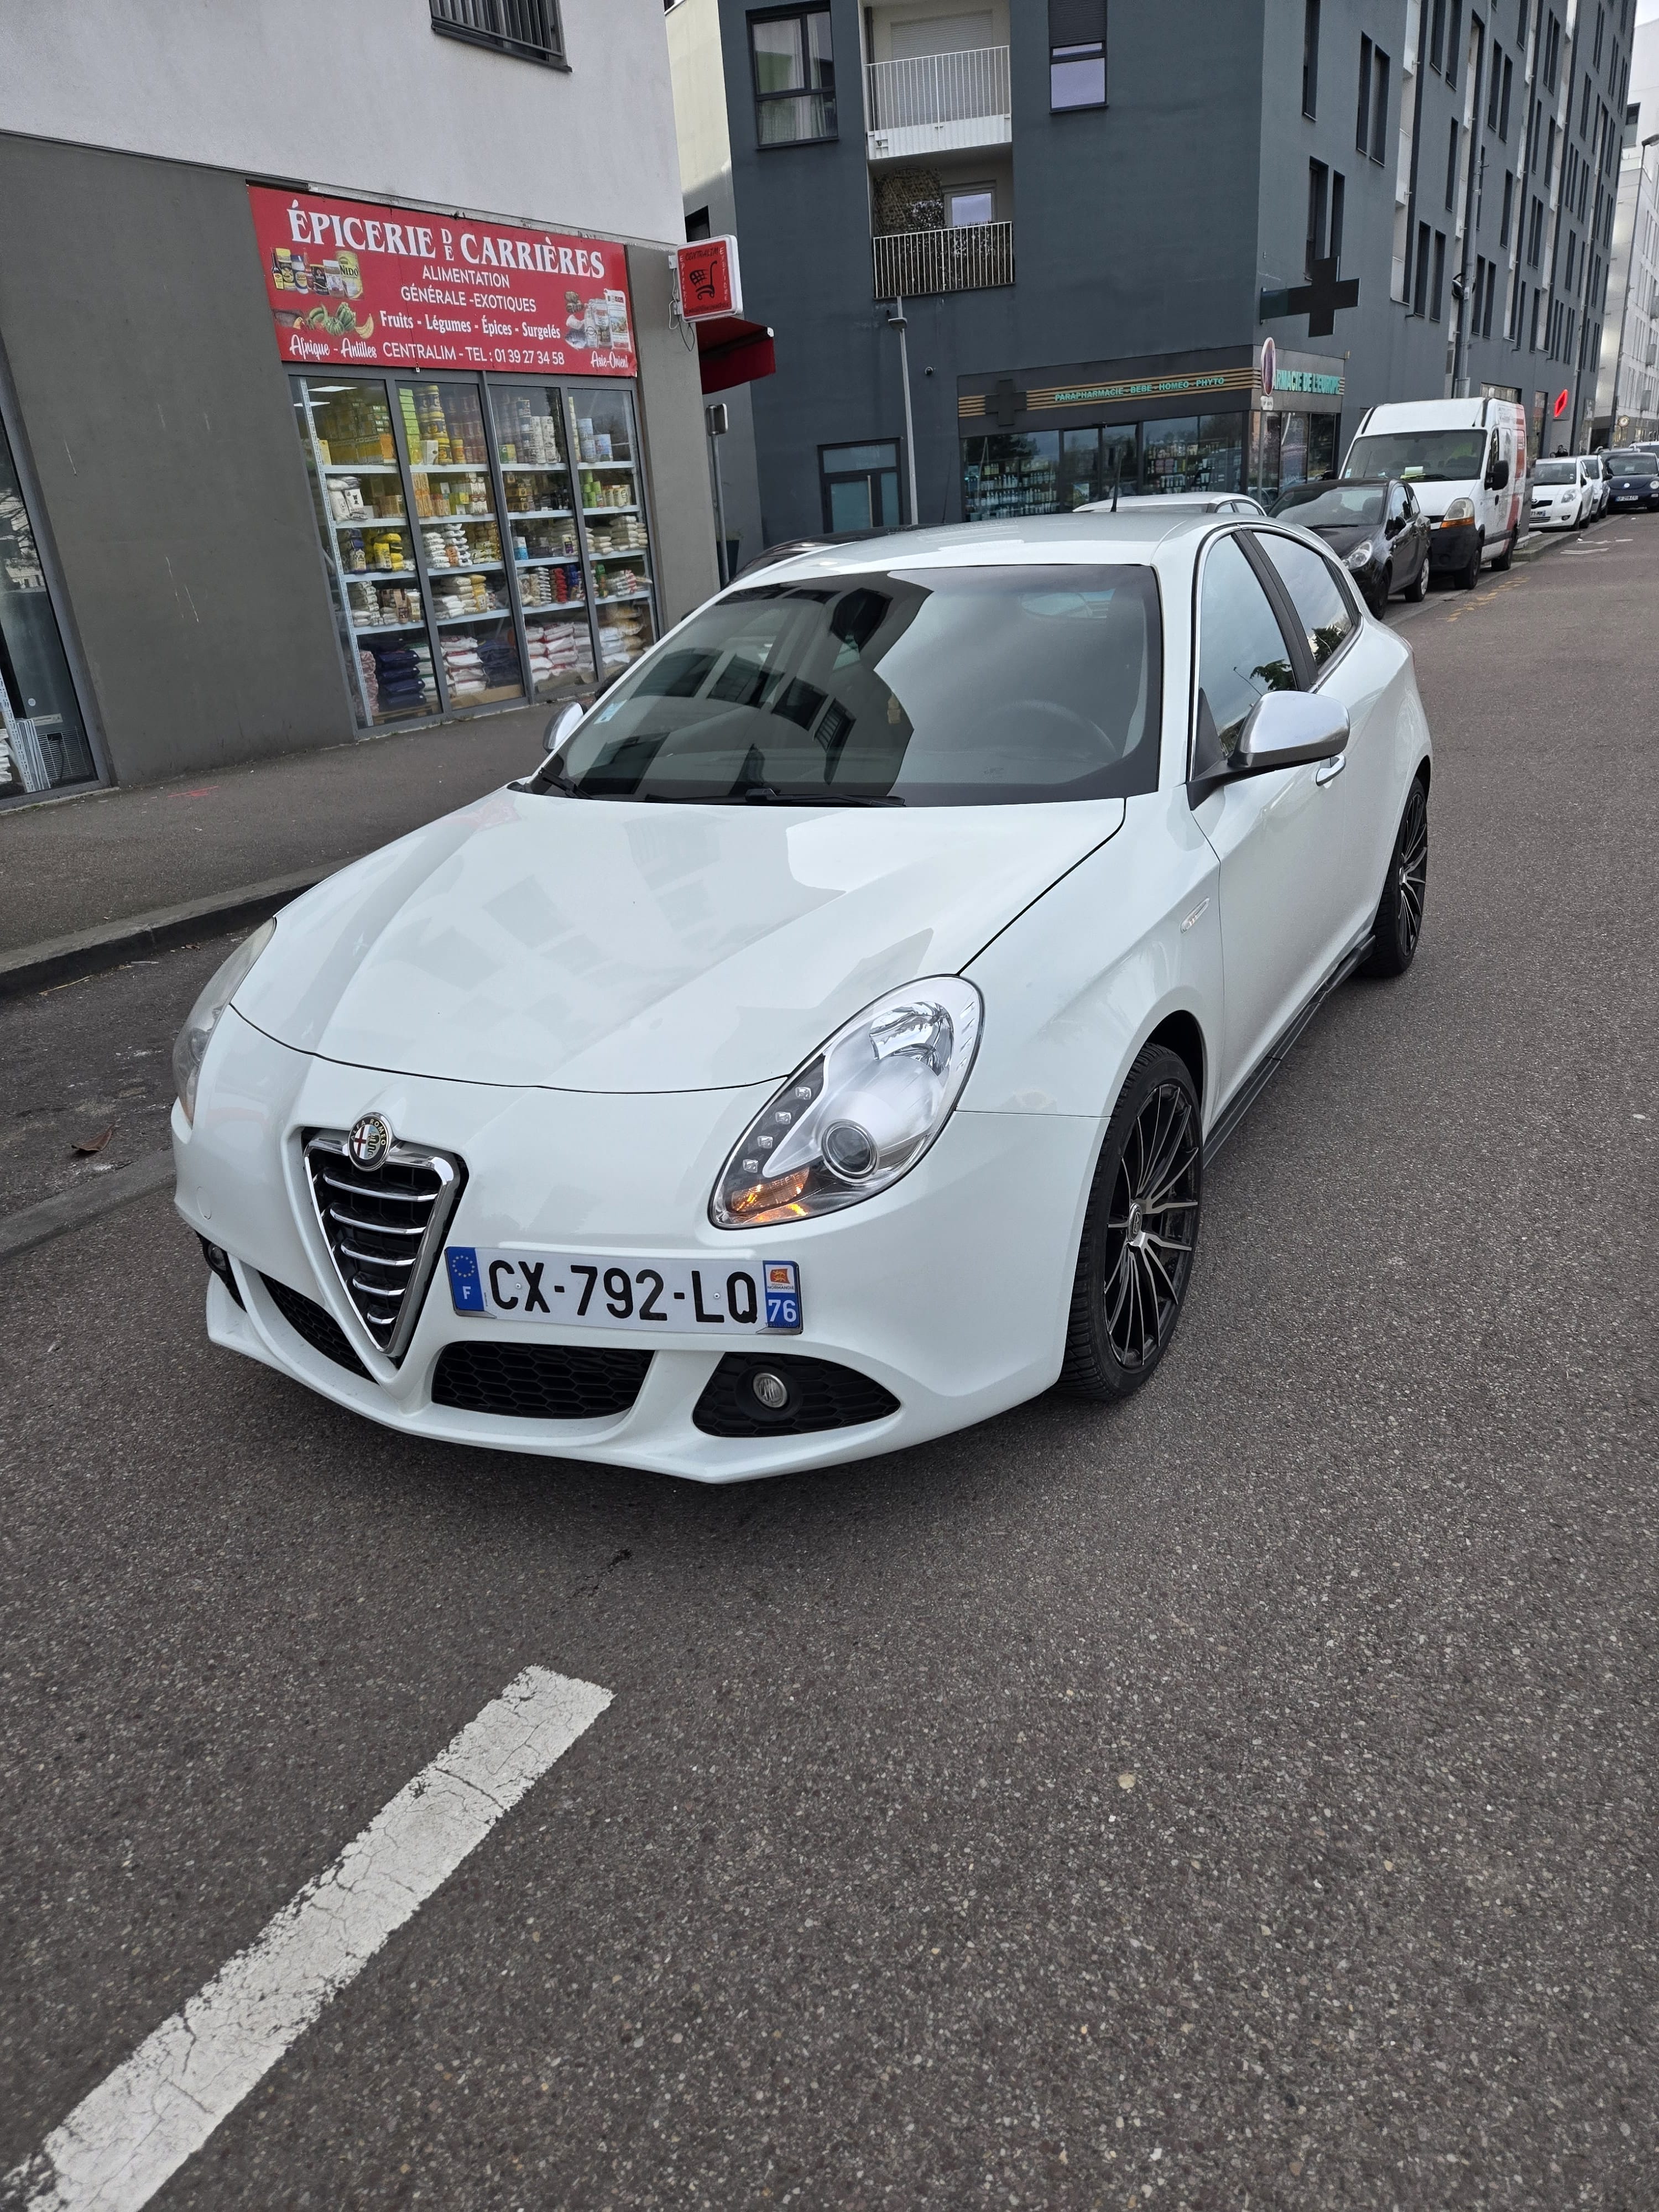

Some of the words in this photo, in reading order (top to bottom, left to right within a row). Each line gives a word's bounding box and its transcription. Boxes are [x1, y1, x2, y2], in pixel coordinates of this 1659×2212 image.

[286, 199, 435, 259] ÉPICERIE
[461, 233, 605, 279] CARRIÈRES
[340, 265, 359, 275] NIDO
[422, 265, 510, 288] ALIMENTATION
[400, 283, 467, 306] GÉNÉRALE
[380, 310, 414, 329] Fruits
[425, 314, 471, 333] Légumes
[482, 315, 512, 337] Épices
[522, 322, 561, 340] Surgelés
[289, 334, 330, 360] Afrique
[341, 337, 377, 358] Antilles
[383, 342, 456, 360] CENTRALIM
[494, 349, 506, 362] 01
[508, 349, 520, 363] 39
[523, 350, 534, 363] 27
[536, 351, 550, 364] 34
[552, 351, 565, 365] 58
[1055, 388, 1124, 401] PARAPHARMACIE
[1130, 384, 1152, 394] BEBE
[1159, 380, 1189, 390] HOMEO
[1196, 378, 1224, 387] PHYTO
[1273, 369, 1302, 391] ARMACIE
[1303, 372, 1312, 392] DE
[351, 1120, 366, 1141] ALFA
[369, 1118, 386, 1146] ROMEO
[462, 1286, 471, 1300] F
[489, 1260, 758, 1323] CX-792-LQ
[768, 1299, 797, 1322] 76
